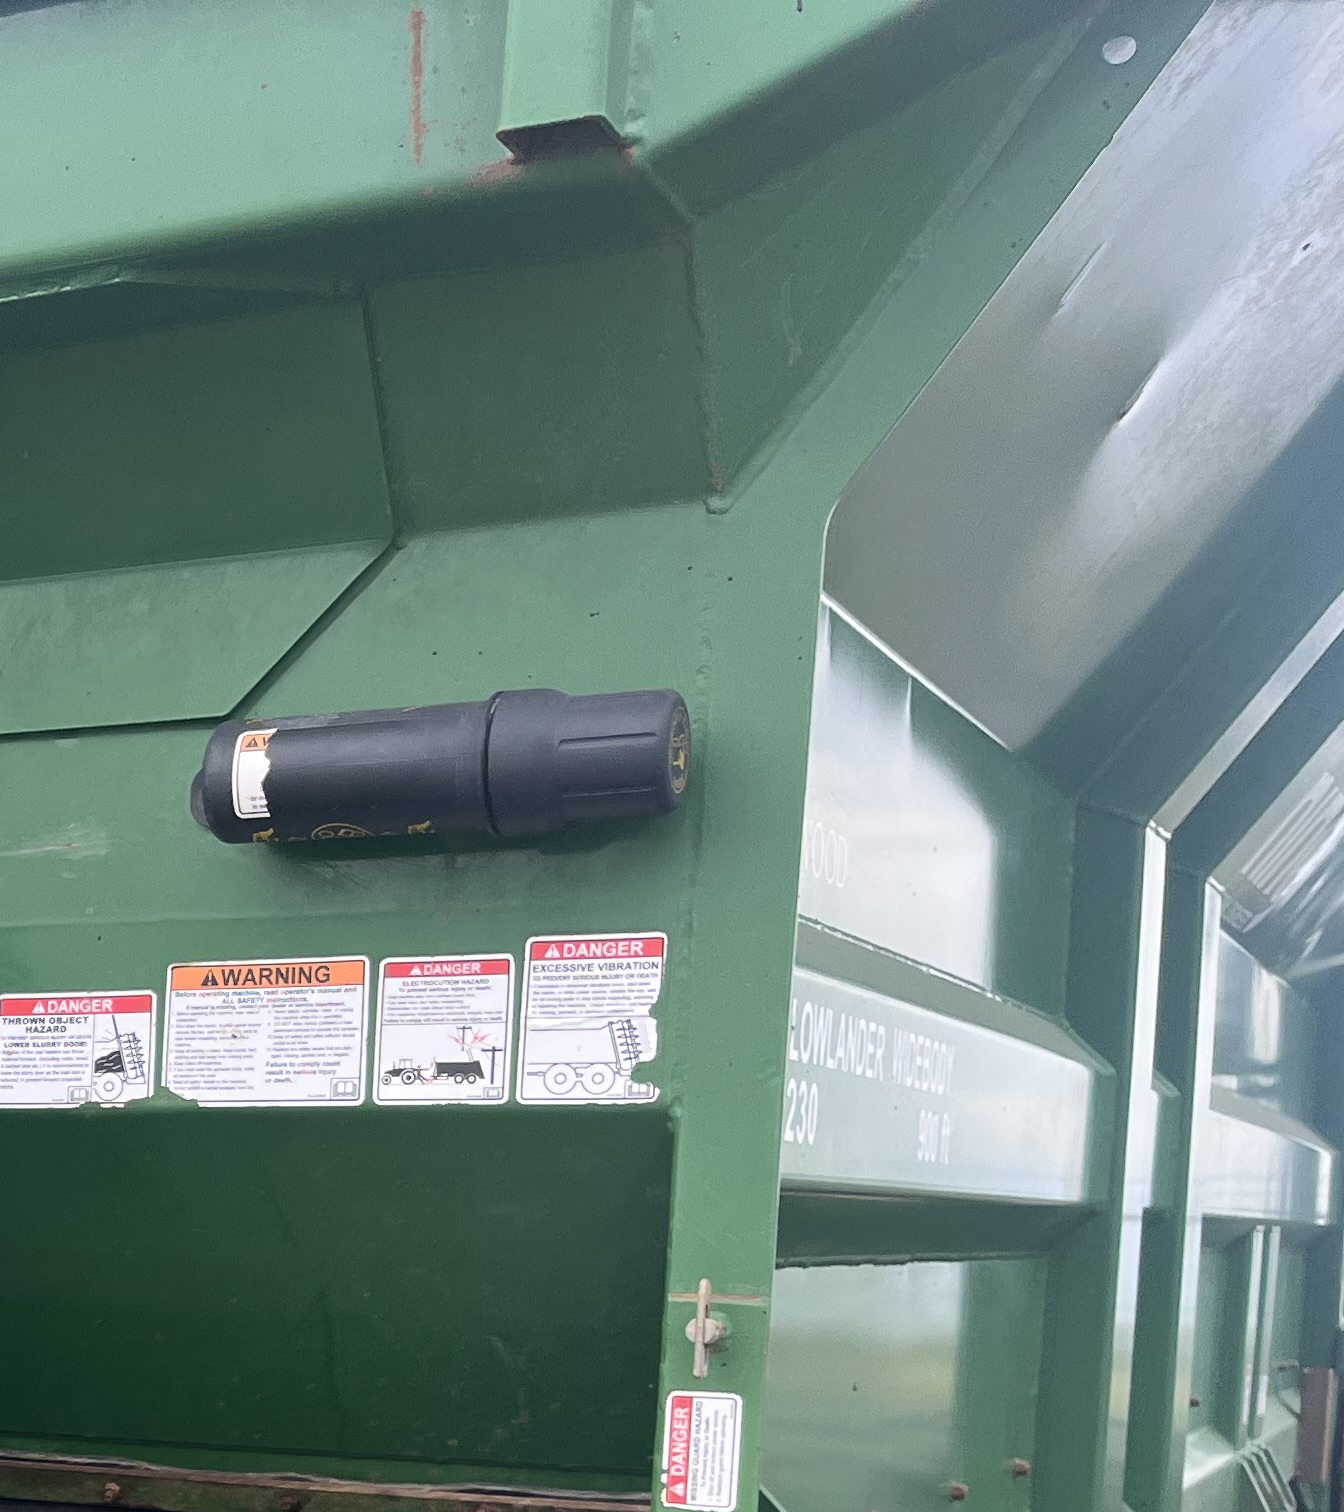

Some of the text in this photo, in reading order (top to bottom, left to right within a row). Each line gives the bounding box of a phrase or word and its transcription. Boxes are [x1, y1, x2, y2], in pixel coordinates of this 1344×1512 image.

[563, 942, 643, 957] DANGER
[423, 963, 481, 975] DANGER
[533, 962, 659, 973] EXCESSIVE VIBRATION
[222, 966, 331, 986] WARNING
[47, 999, 114, 1013] DANGER
[2, 1017, 45, 1025] THROWN
[789, 999, 955, 1095] LOWLANDER WIDEBODY
[783, 1078, 818, 1145] 230
[672, 1407, 690, 1476] DANGER
